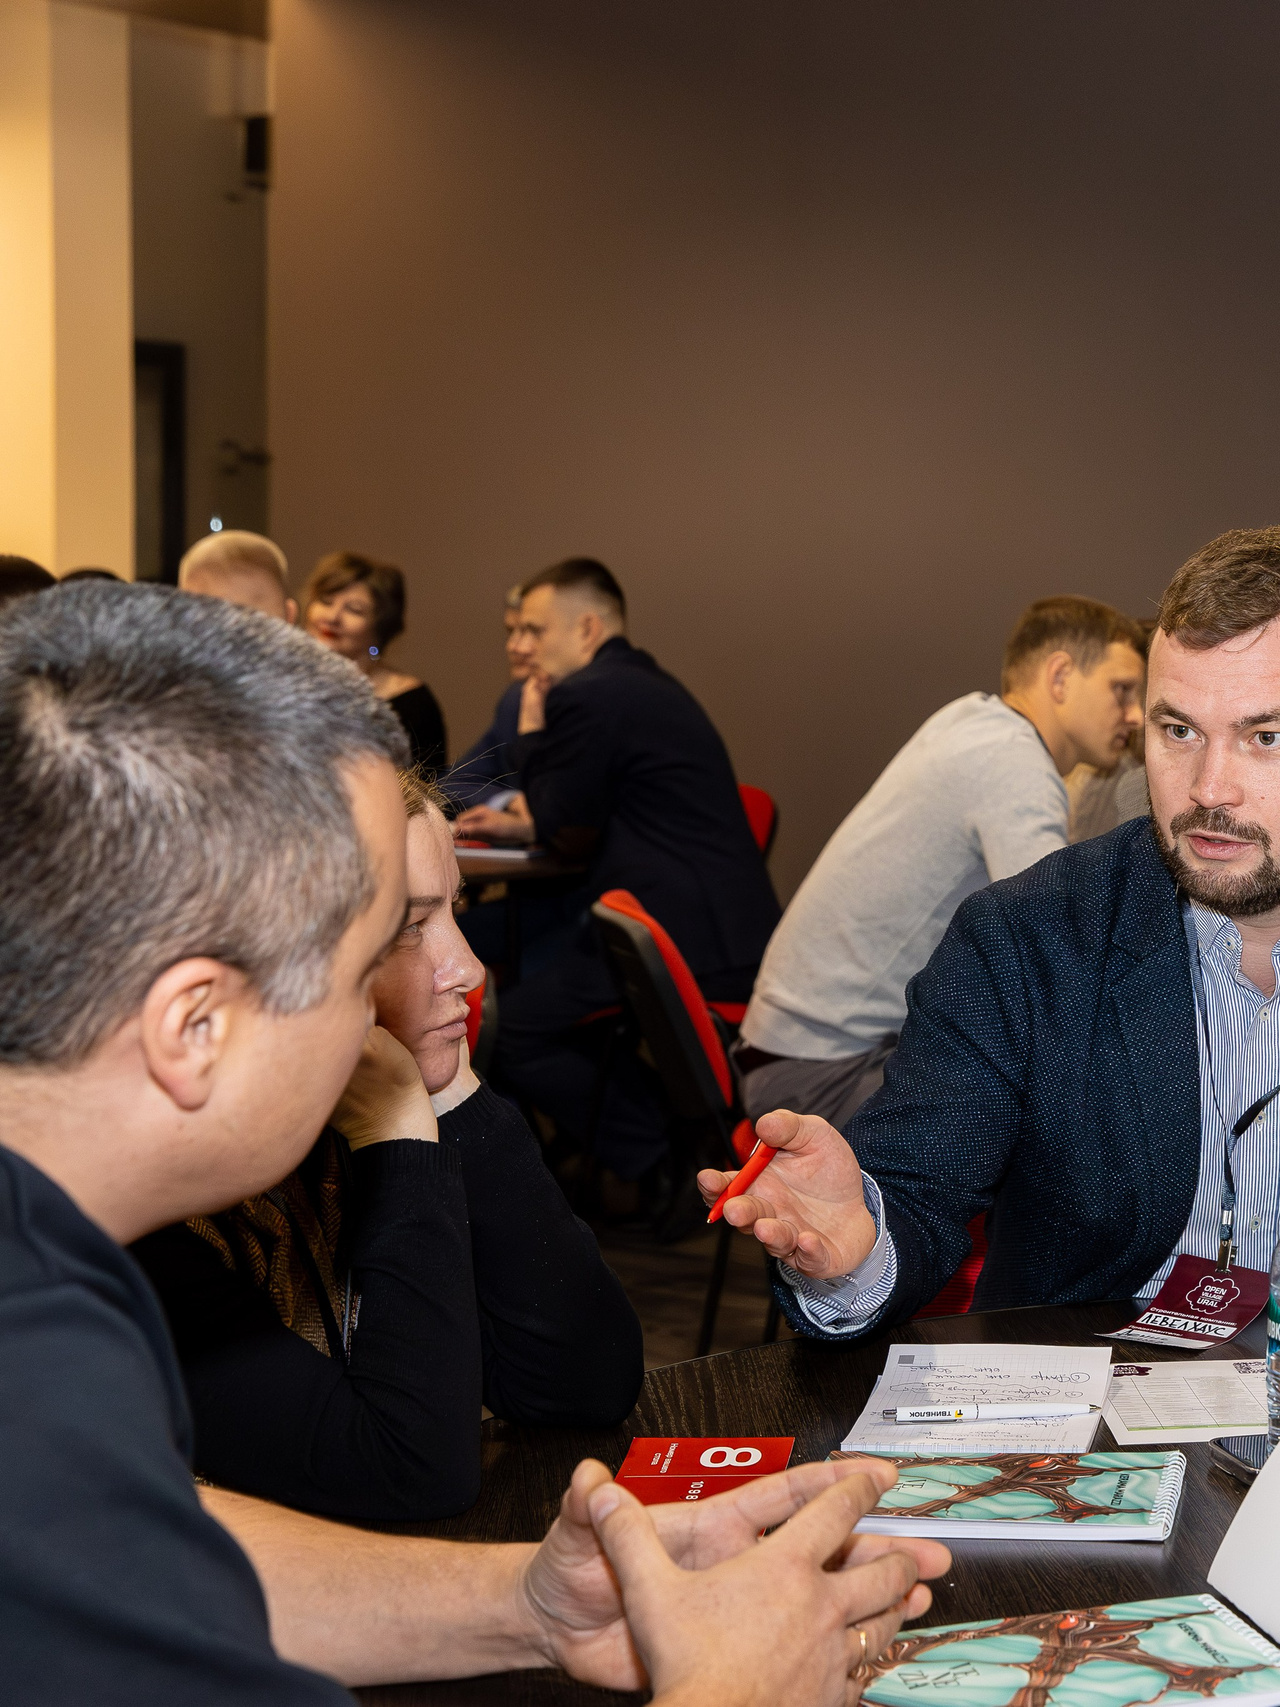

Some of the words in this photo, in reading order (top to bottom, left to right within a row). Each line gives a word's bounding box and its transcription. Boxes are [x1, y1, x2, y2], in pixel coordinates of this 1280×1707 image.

[1203, 1284, 1228, 1295] OPEN
[1201, 1291, 1224, 1301] VILLAGE
[1196, 1297, 1219, 1308] URAL
[909, 1410, 952, 1418] ТВИНБЛОК
[700, 1446, 763, 1468] 8
